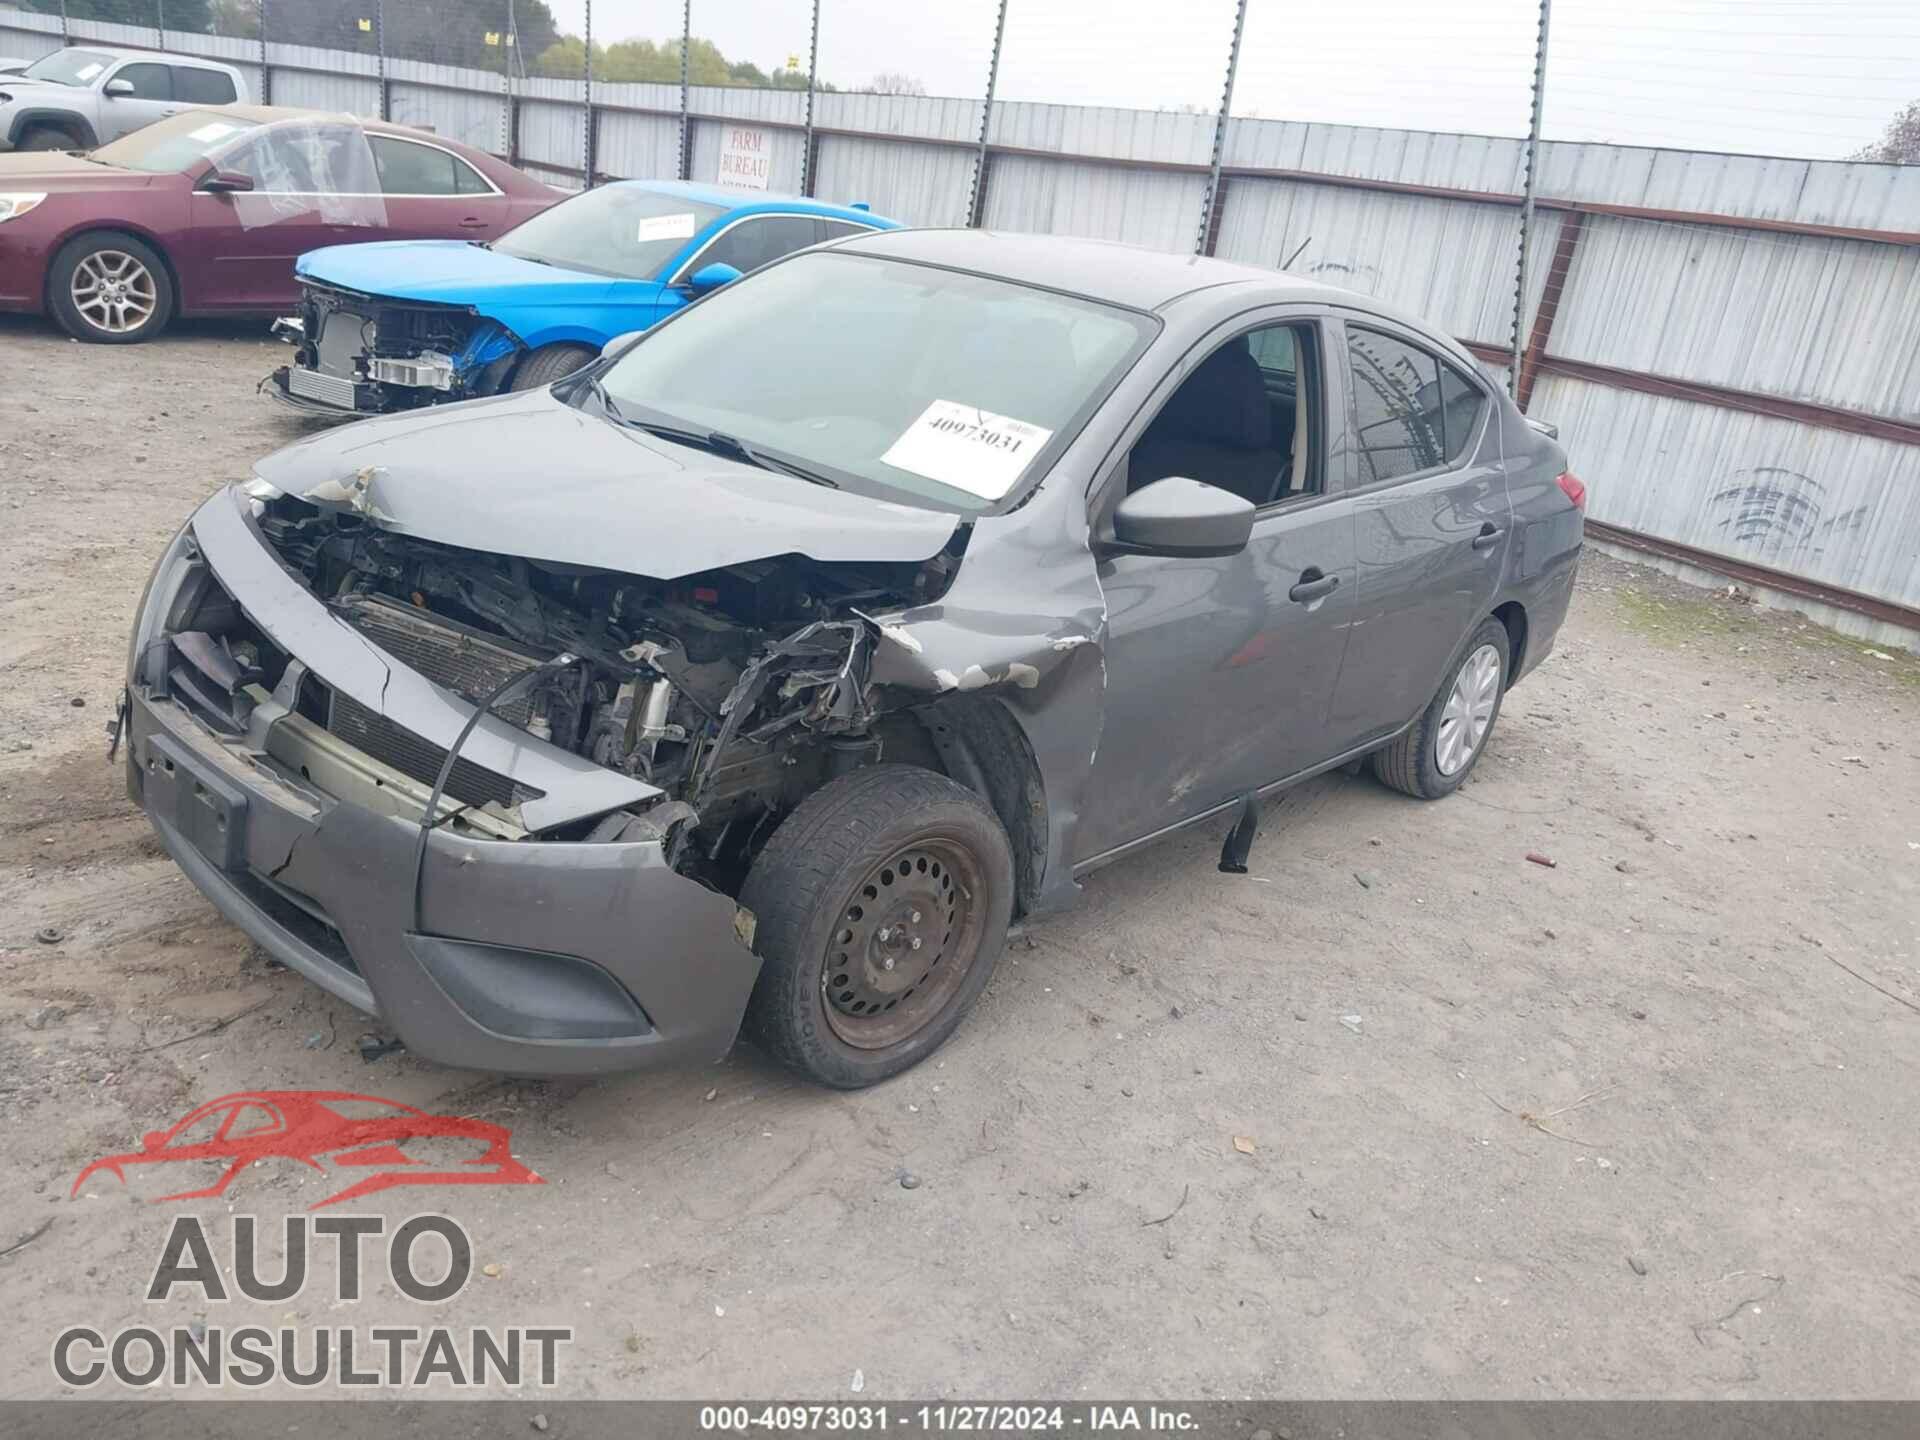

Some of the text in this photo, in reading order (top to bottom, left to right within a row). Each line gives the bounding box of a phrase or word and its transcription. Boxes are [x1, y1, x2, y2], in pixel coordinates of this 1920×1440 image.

[731, 130, 762, 152] FARM
[721, 153, 768, 178] BUREAU
[929, 417, 1023, 453] 40973031
